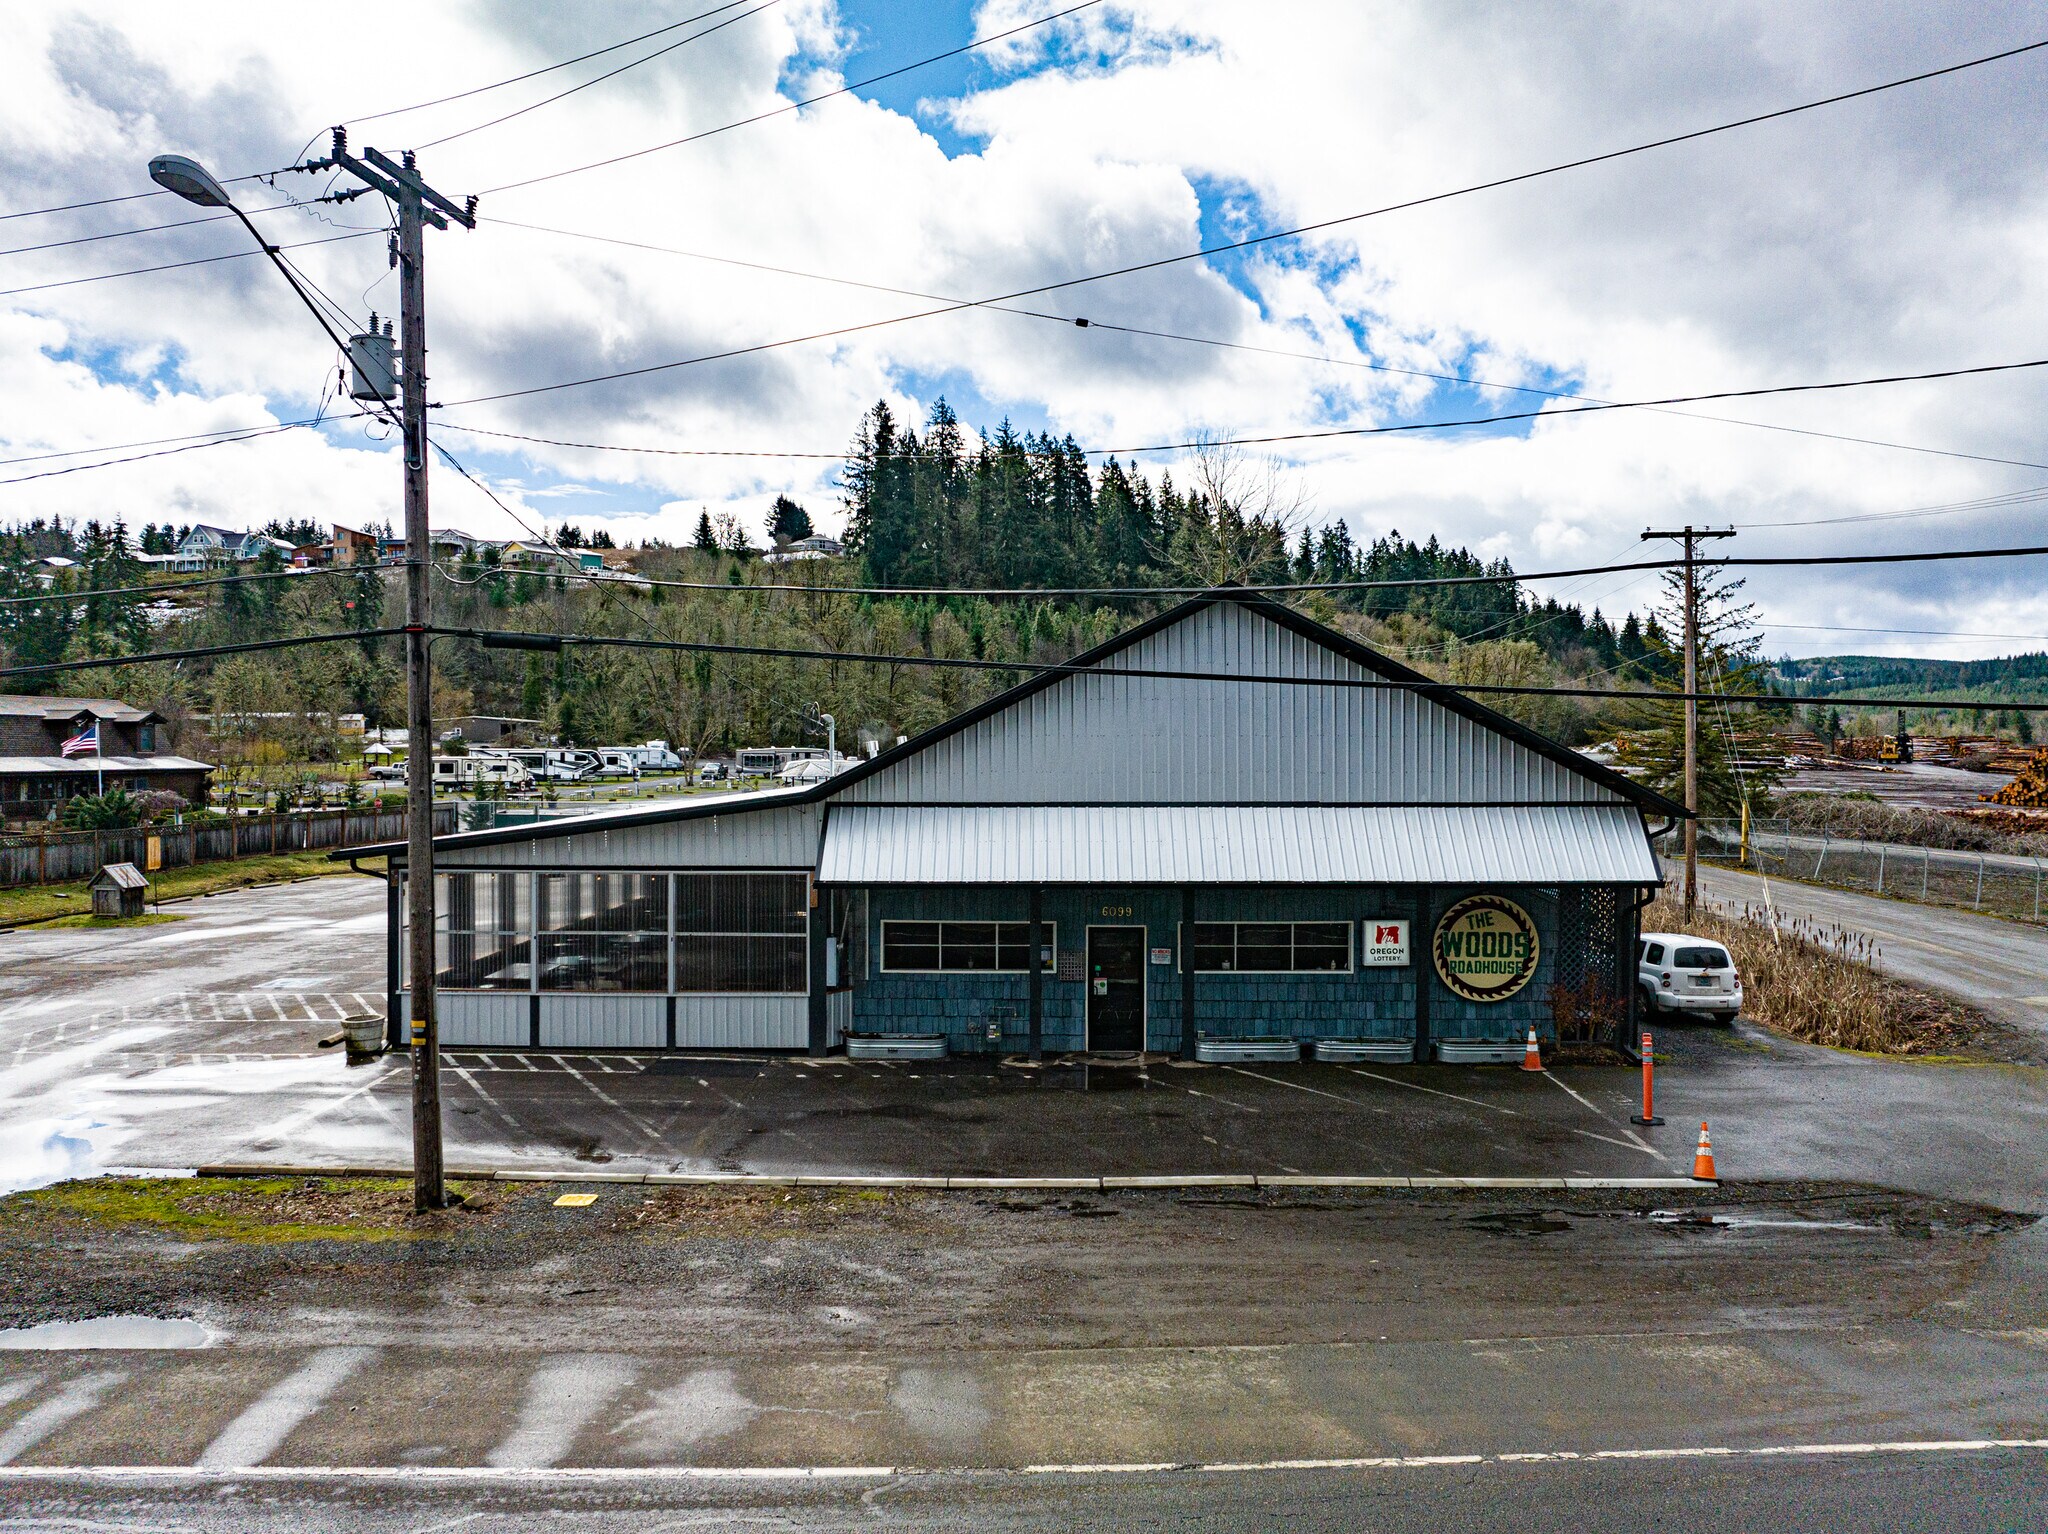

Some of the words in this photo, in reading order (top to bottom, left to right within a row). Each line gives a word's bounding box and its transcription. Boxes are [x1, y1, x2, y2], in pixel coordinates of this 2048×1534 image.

[1102, 906, 1132, 917] 6099
[1466, 911, 1495, 930] THE
[1370, 947, 1404, 955] OREGON
[1442, 931, 1529, 959] WOODS
[1450, 960, 1523, 975] ROADHOUSE
